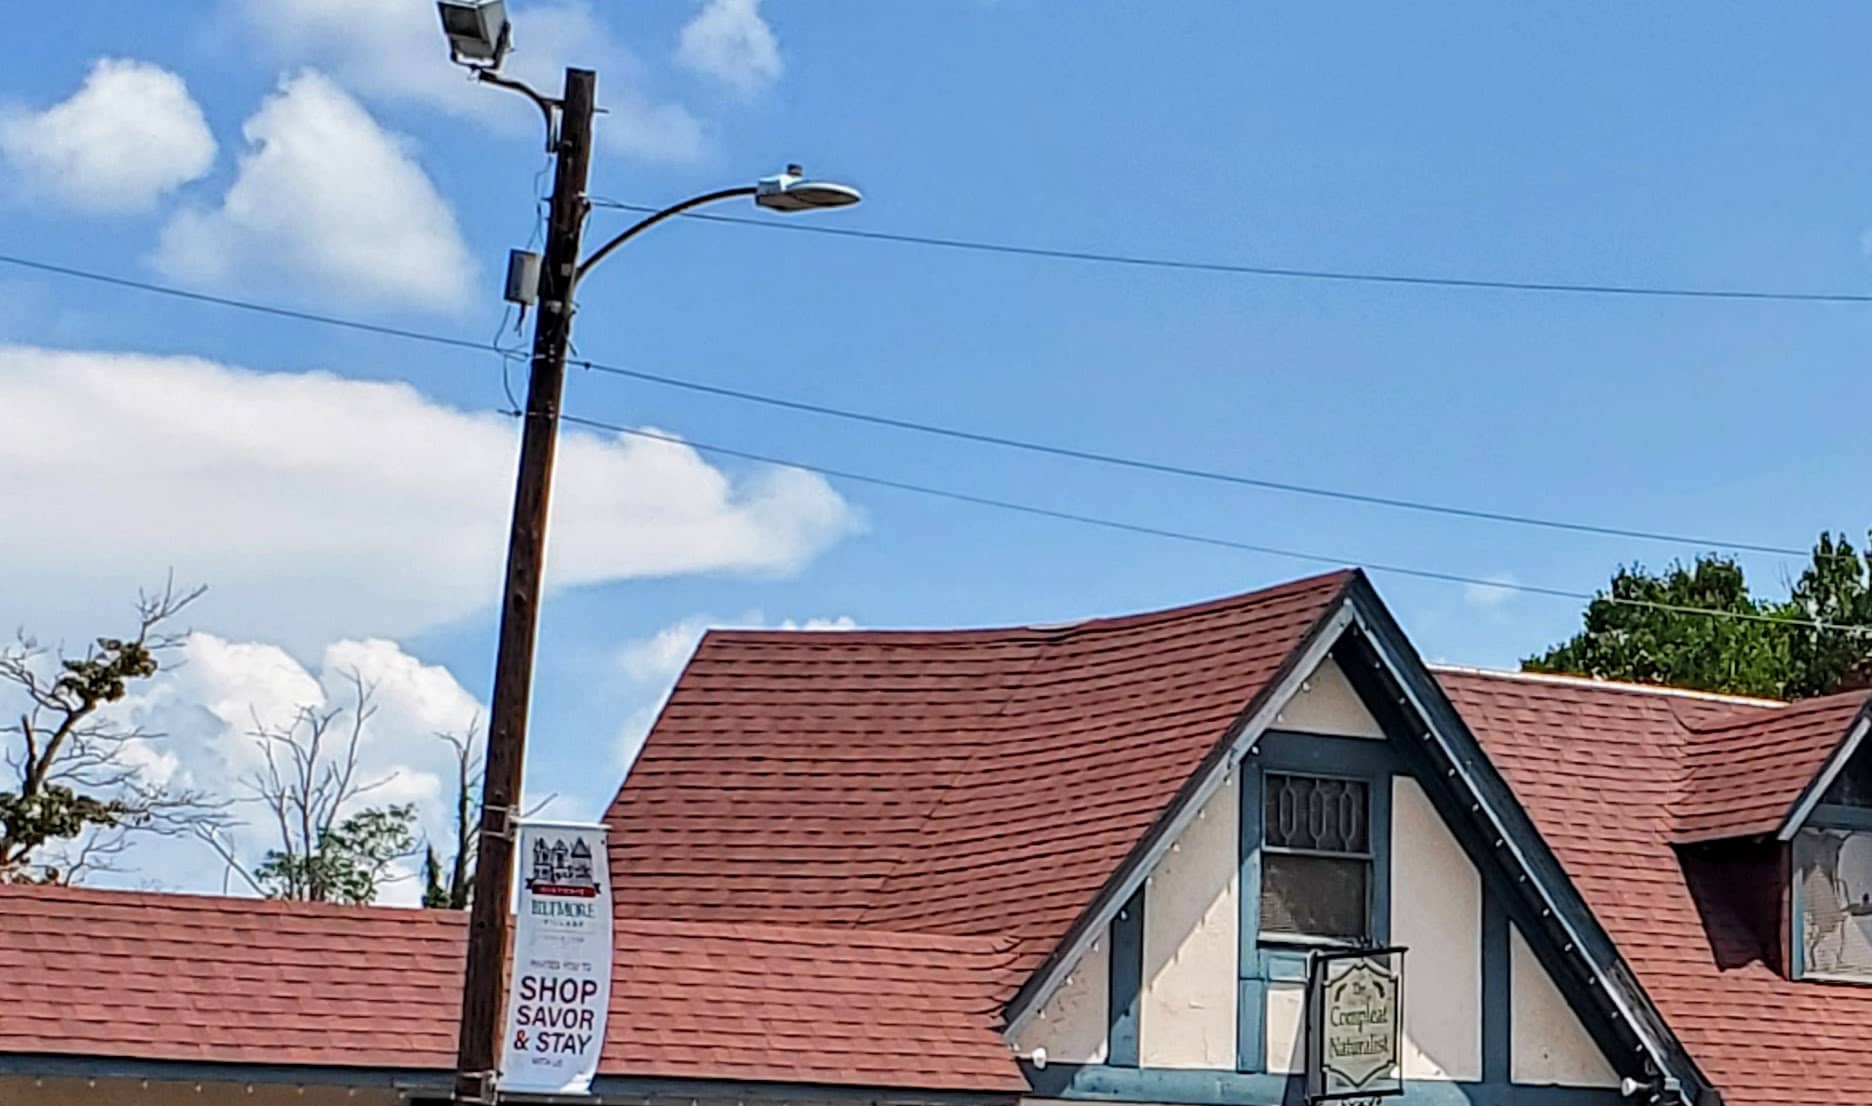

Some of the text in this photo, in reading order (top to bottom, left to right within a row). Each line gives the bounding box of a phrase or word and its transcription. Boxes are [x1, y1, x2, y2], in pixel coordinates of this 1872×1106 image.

[531, 899, 596, 918] BILTMORE
[519, 975, 598, 1004] SHOP
[516, 1005, 594, 1031] SAVOR
[513, 1029, 592, 1055] & STAY
